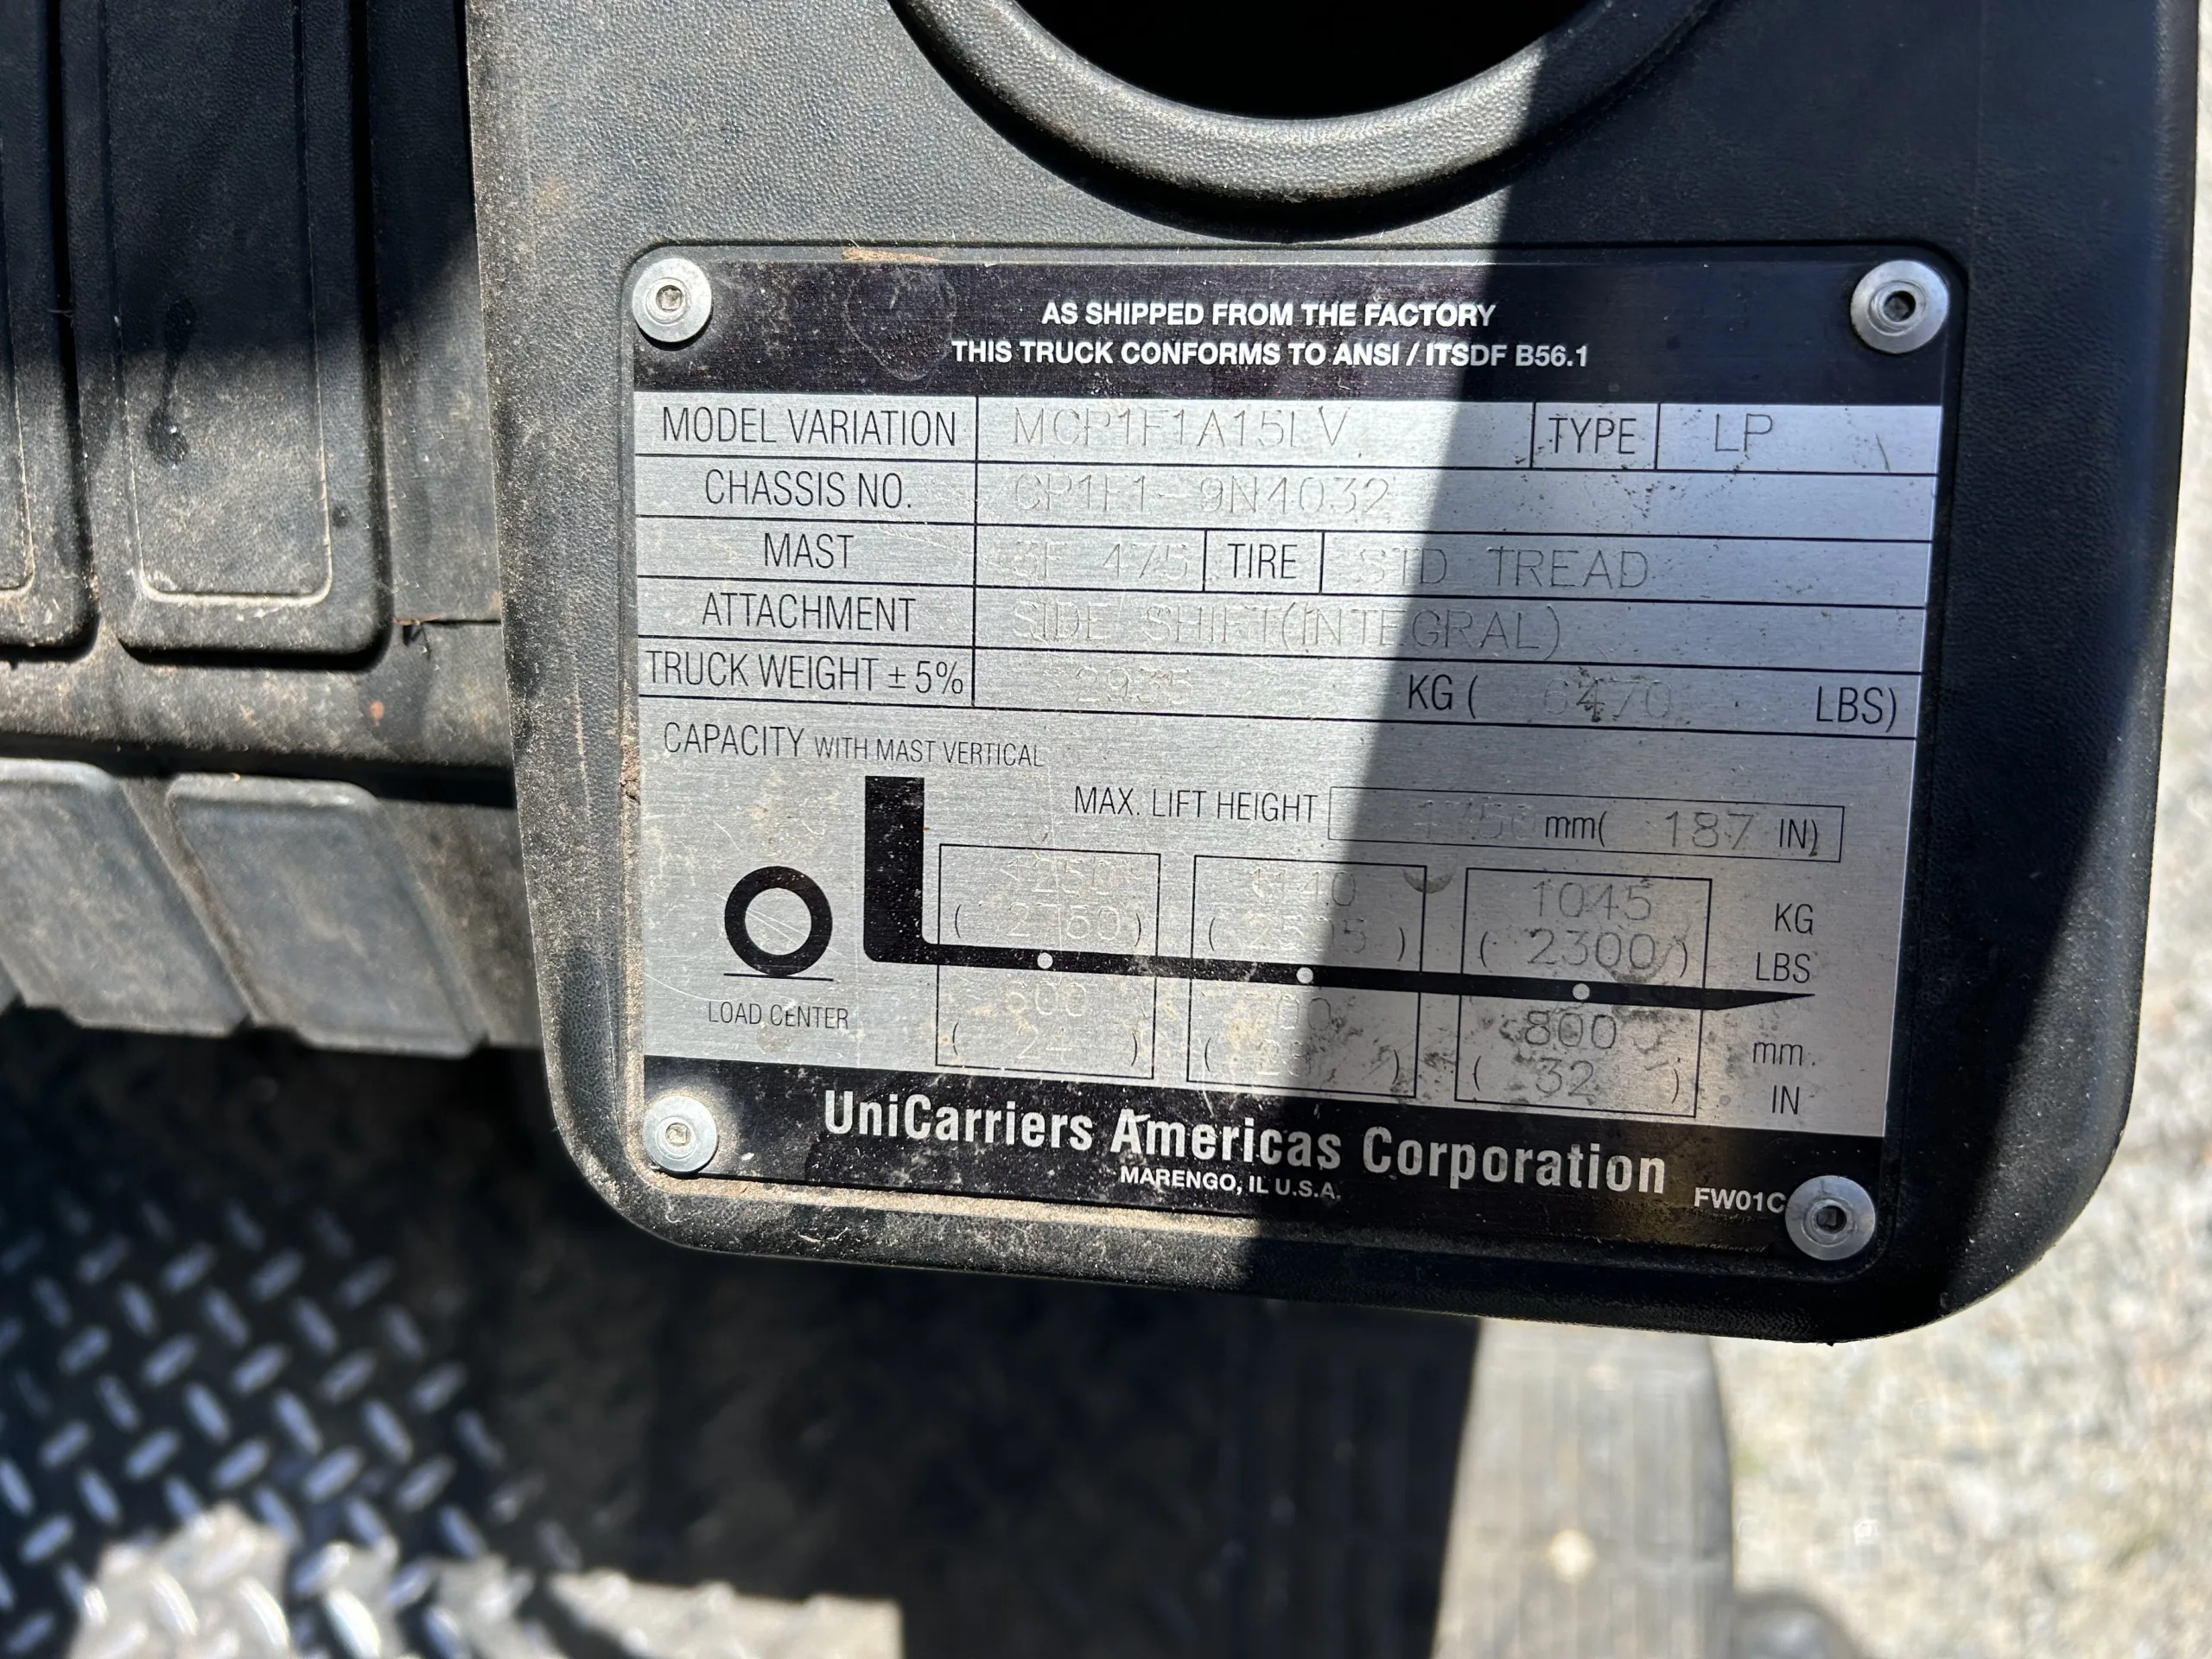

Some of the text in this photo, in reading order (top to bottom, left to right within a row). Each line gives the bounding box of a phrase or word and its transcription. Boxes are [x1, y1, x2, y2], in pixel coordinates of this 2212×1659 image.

[1041, 302, 1496, 327] AS SHIPPED FROM THE FACTORY
[951, 340, 1013, 364] THIS
[1020, 341, 1114, 364] TRUCK
[1121, 341, 1281, 365] CONFORMS
[1287, 343, 1326, 366] TO
[1333, 344, 1399, 366] ANSI
[1426, 343, 1507, 367] ITSDF
[1516, 344, 1587, 367] B56.1
[663, 406, 957, 447] MODEL VARIATION
[1548, 416, 1637, 455] TYPE
[1714, 413, 1773, 453] LP
[705, 469, 912, 510] CHASSIS NO.
[764, 533, 854, 569] MAST
[1227, 543, 1297, 579] TIRE
[1360, 545, 1648, 589] STD TREAD
[702, 592, 916, 632] ATTACHMENT
[1014, 602, 1110, 641] SIDE
[646, 651, 749, 687] TRUCK
[759, 655, 875, 691] WEIGHT
[664, 722, 1045, 767] CAPACITY WITH MAST VERTICAL
[1076, 786, 1319, 823] MAX. LIFT HEIGHT
[1664, 810, 1760, 851] 187
[1532, 880, 1652, 921] 1045
[1774, 903, 1814, 936] KG
[1756, 951, 1811, 985] LBS
[709, 1001, 849, 1030] LOAD CENTER
[1525, 1010, 1617, 1049] 800
[1772, 1085, 1800, 1116] IN
[825, 1090, 1667, 1194] UniCarriers Americas Corporation
[1121, 1166, 1342, 1200] MARENGO, IL U.S.A.
[1694, 1186, 1787, 1213] FW01C
